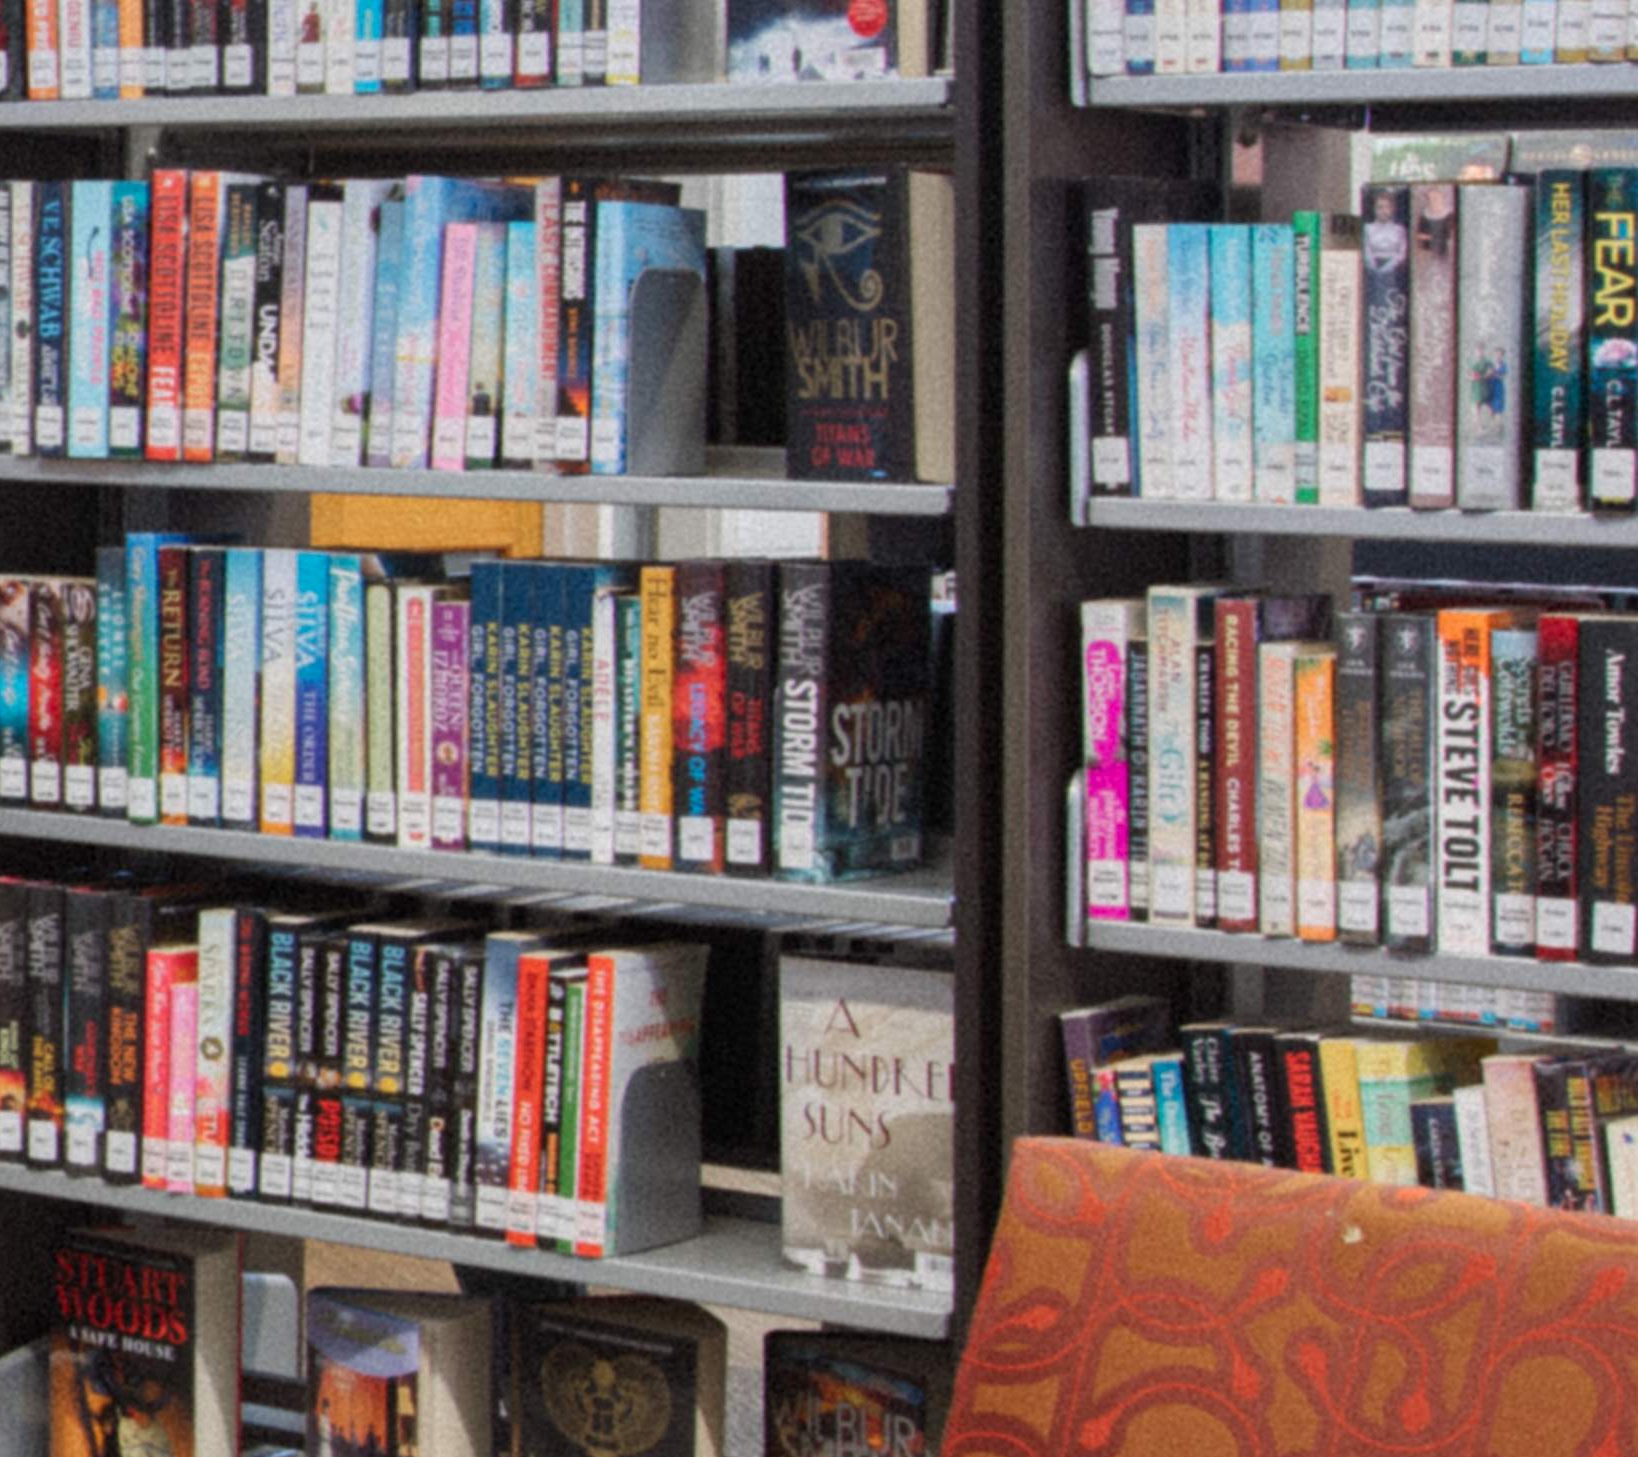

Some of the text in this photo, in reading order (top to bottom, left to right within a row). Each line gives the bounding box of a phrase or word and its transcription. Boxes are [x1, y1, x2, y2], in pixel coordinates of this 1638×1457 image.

[194, 196, 210, 233] LISA
[39, 236, 61, 338] SCHWAB
[153, 196, 177, 353] LISA SCOTTOLINE
[192, 239, 211, 341] SCOTTOLINE
[1548, 182, 1572, 372] HER LAST HOLIDAY
[1593, 210, 1637, 327] FEAR
[791, 319, 899, 363] WILBUR
[796, 354, 890, 400] SMITH
[162, 589, 180, 687] RETURN
[689, 683, 706, 782] LEGACY OF
[781, 679, 819, 775] STORM
[1224, 614, 1242, 853] RACING THE DEVIL CHARLES
[1604, 648, 1627, 776] Amor Towles
[1443, 700, 1480, 895] STEVE TOLT
[345, 941, 373, 1068] BLACK RIVER
[377, 945, 405, 1072] BLACK RIVER
[824, 997, 861, 1039] A
[803, 1102, 891, 1151] SUNS
[53, 1248, 189, 1309] STUART
[57, 1286, 191, 1346] WOODS
